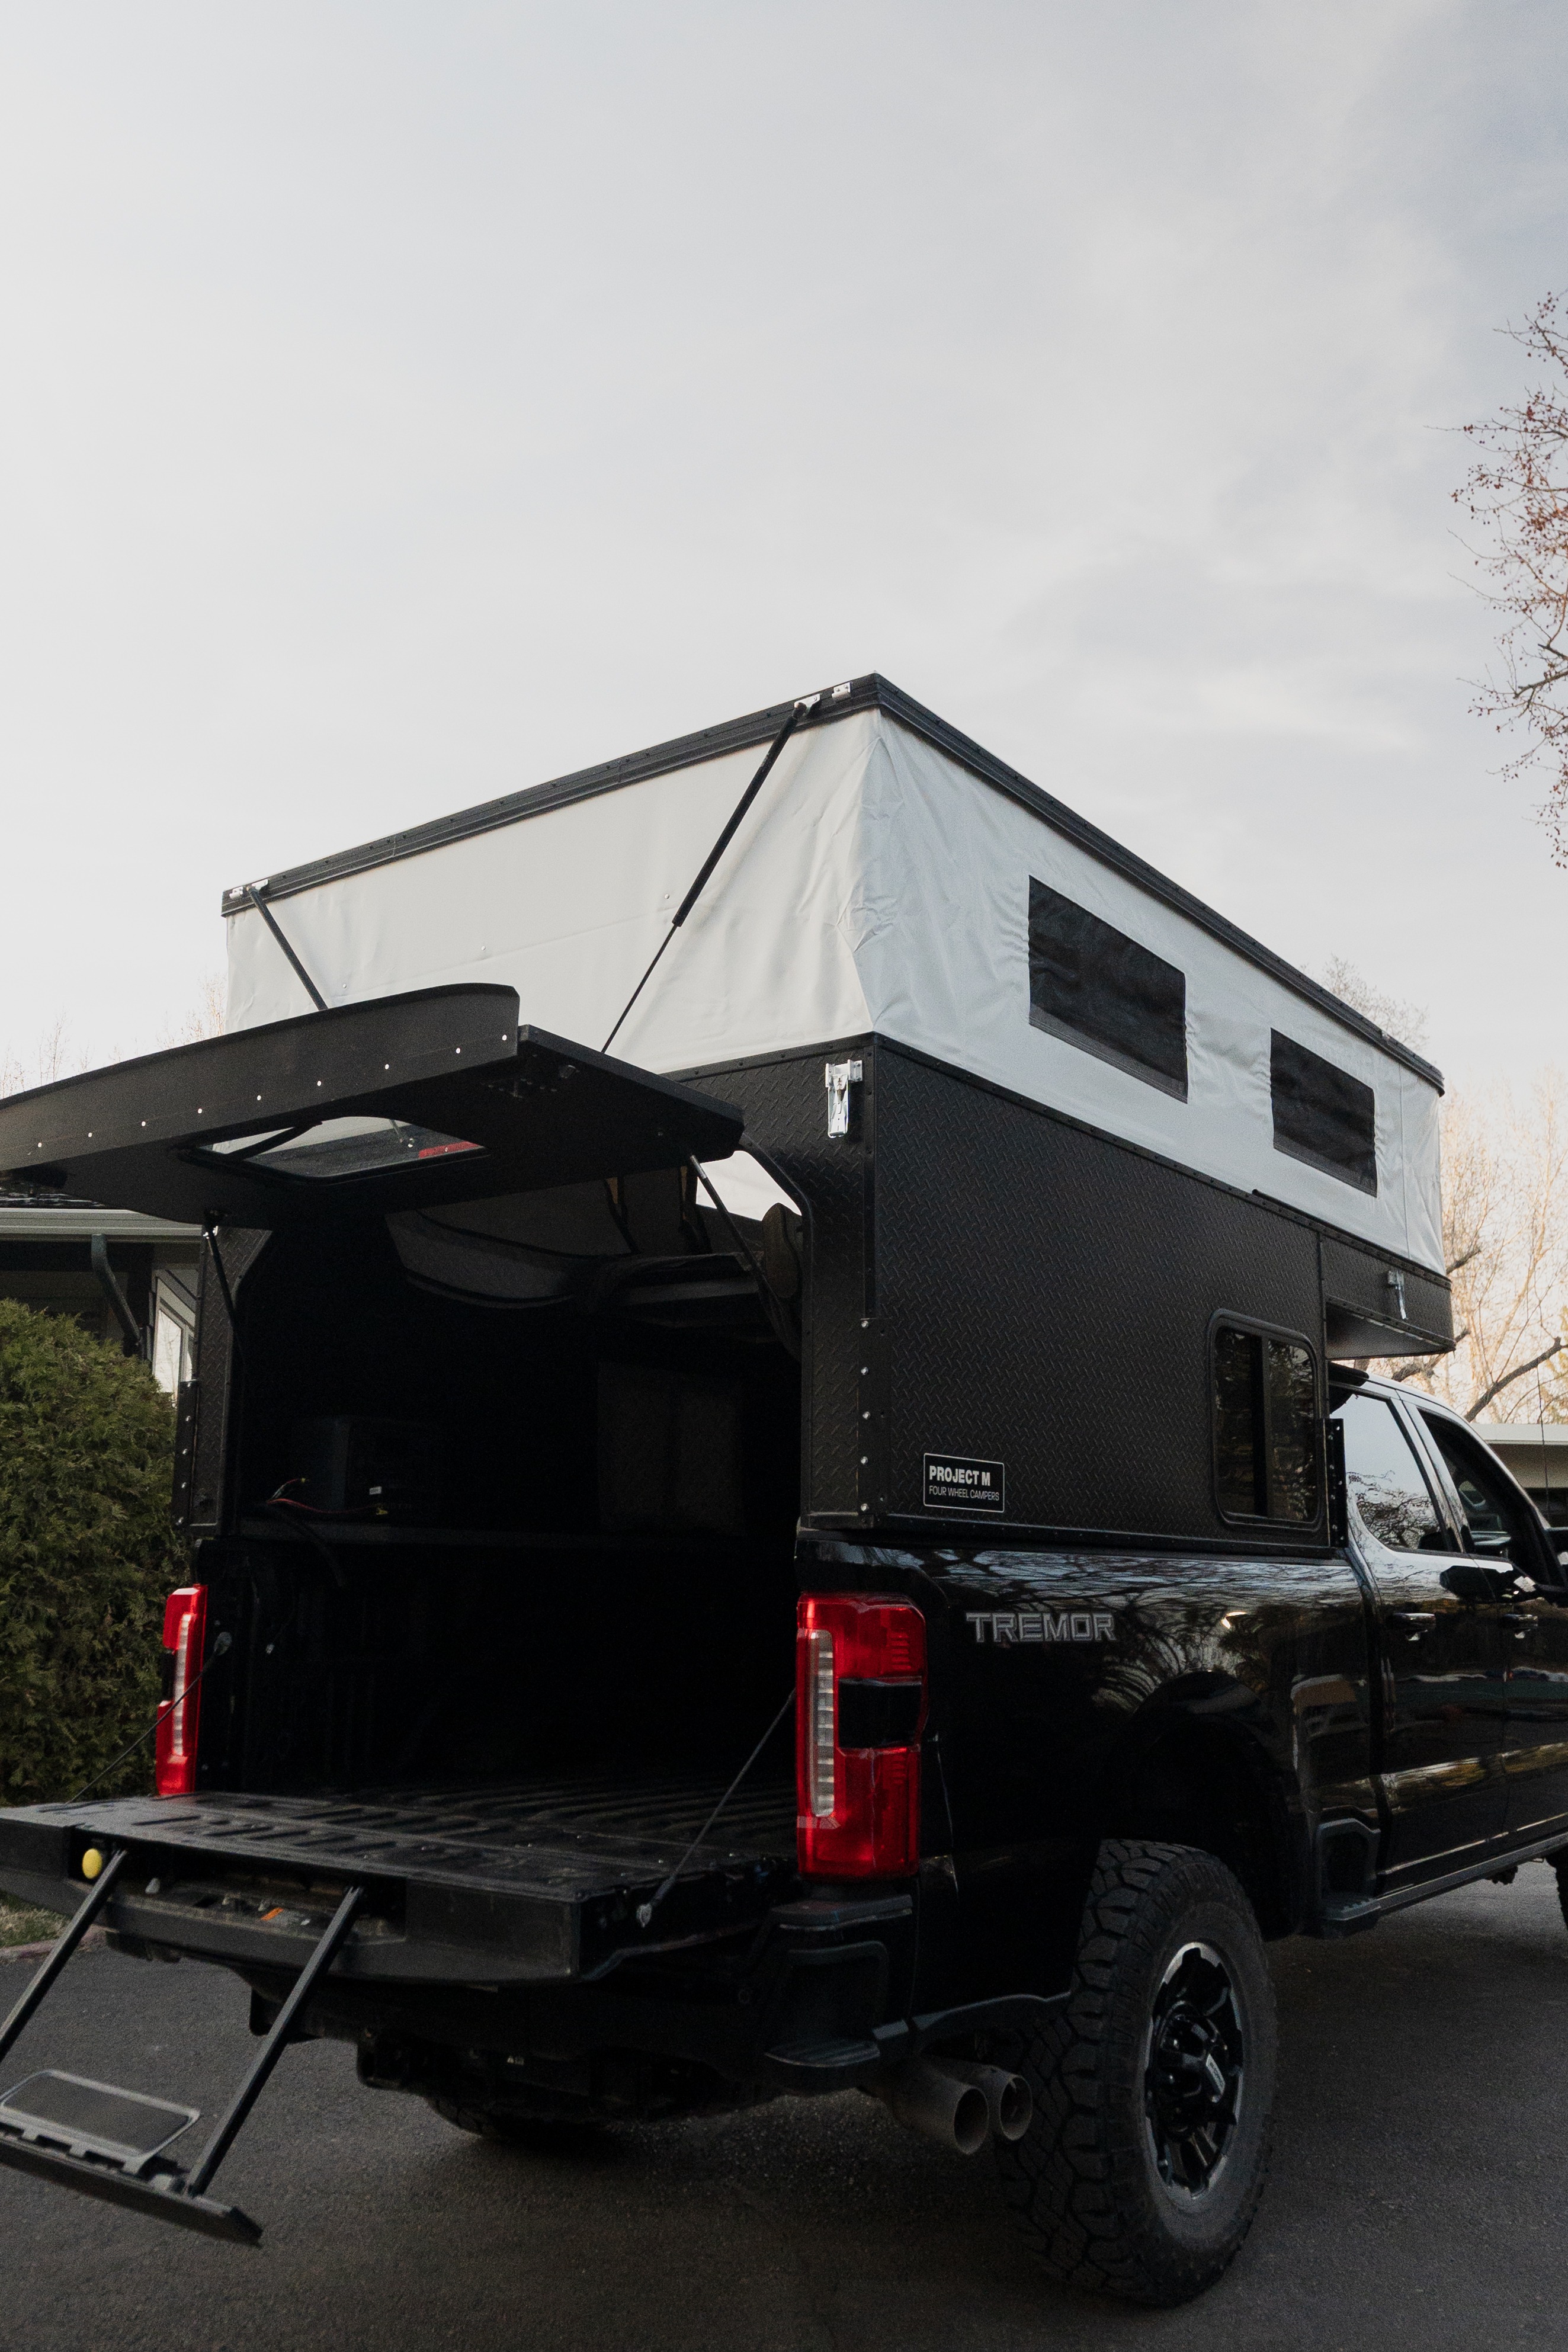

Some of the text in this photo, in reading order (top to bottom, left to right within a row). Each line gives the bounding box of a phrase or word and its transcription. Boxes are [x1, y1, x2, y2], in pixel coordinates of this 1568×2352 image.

[929, 1465, 990, 1486] PROJECT M
[929, 1485, 999, 1501] FOUR WHEEL CAMPERS
[966, 1612, 1117, 1643] TREMOR
